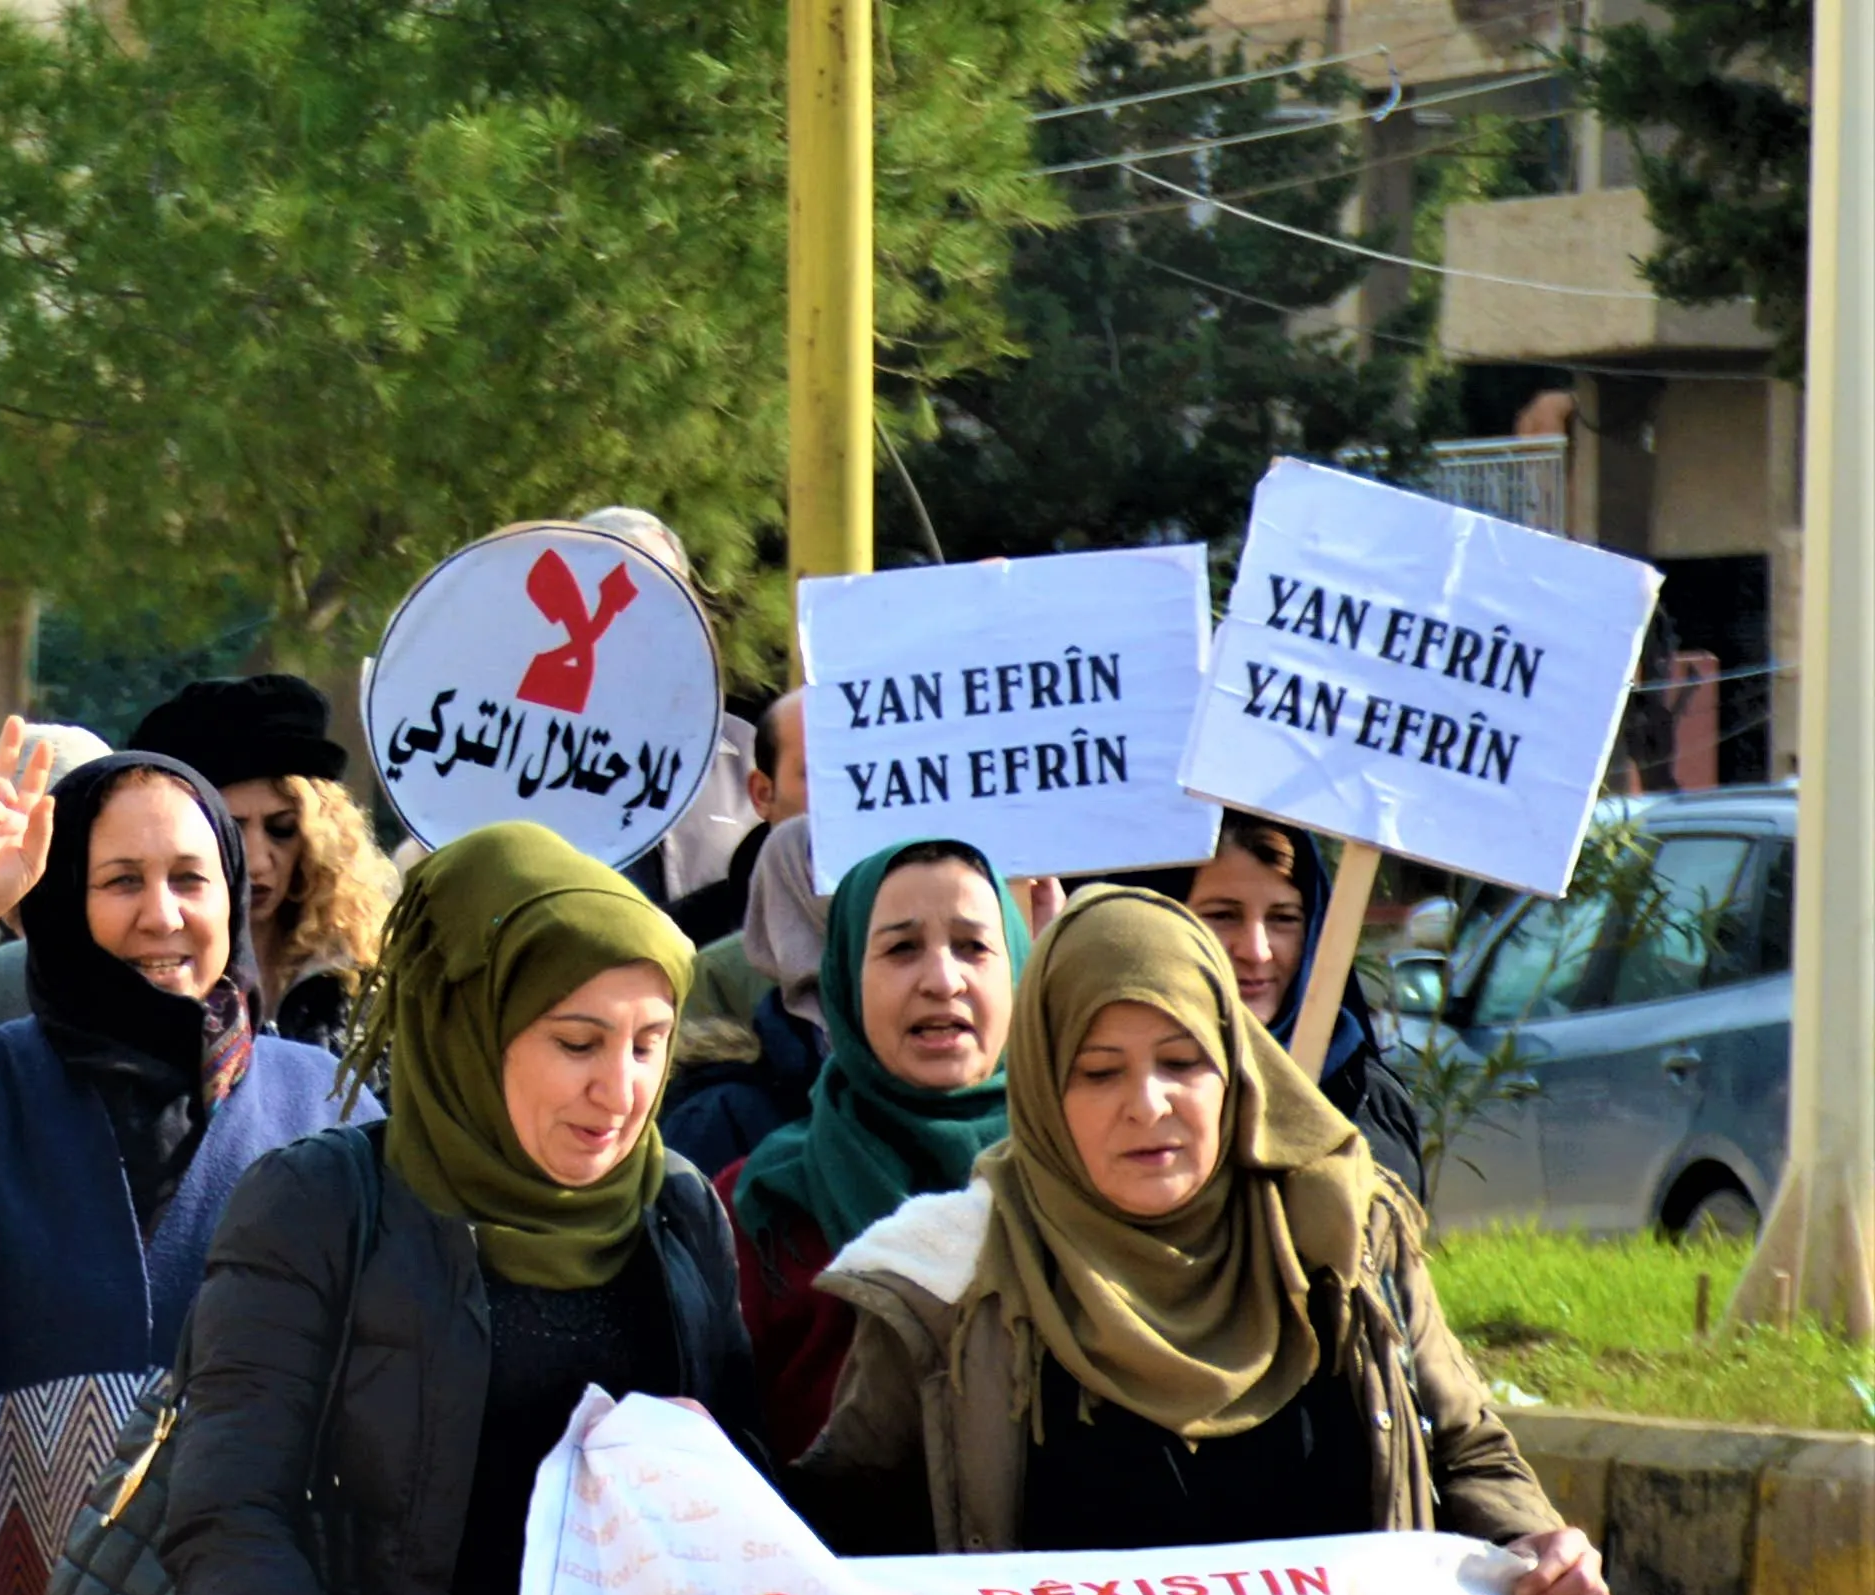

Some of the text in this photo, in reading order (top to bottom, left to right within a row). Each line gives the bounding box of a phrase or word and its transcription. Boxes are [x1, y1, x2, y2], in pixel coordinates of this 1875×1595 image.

[515, 548, 640, 715] لا
[838, 646, 1122, 729] YAN EFRÎN
[1267, 573, 1545, 700] YAN EFRÎN
[386, 688, 683, 831] للإحتلال التركي
[845, 727, 1128, 812] YAN EFRÎN
[1243, 661, 1521, 785] YAN EFRÎN
